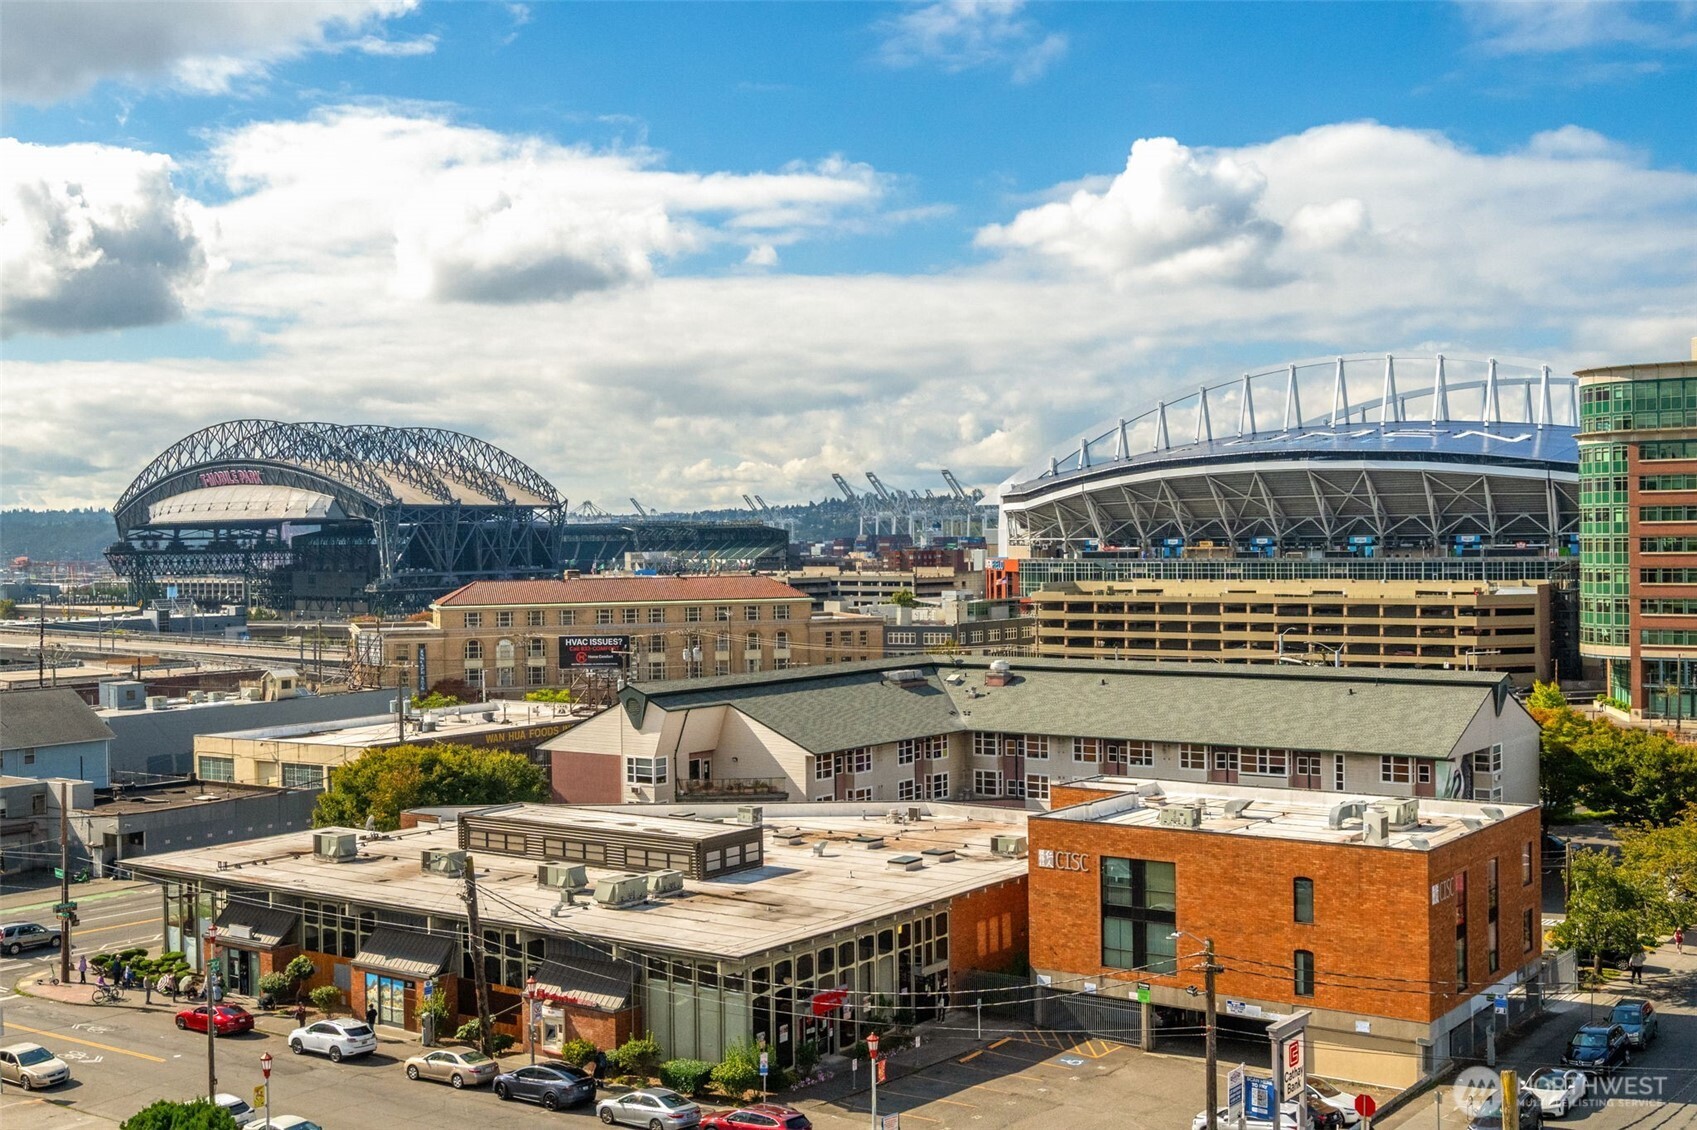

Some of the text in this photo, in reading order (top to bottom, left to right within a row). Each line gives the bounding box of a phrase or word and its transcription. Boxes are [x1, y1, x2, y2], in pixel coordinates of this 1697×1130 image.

[199, 469, 263, 487] T-MOBILE PARK
[565, 638, 623, 646] HVAC ISSUES?
[486, 732, 505, 744] WAN
[508, 730, 526, 741] HUA
[529, 726, 560, 739] FOODS
[1055, 851, 1089, 872] CISC
[1440, 877, 1454, 901] CISC
[1285, 1066, 1303, 1083] Cathay
[1287, 1077, 1301, 1095] Bank
